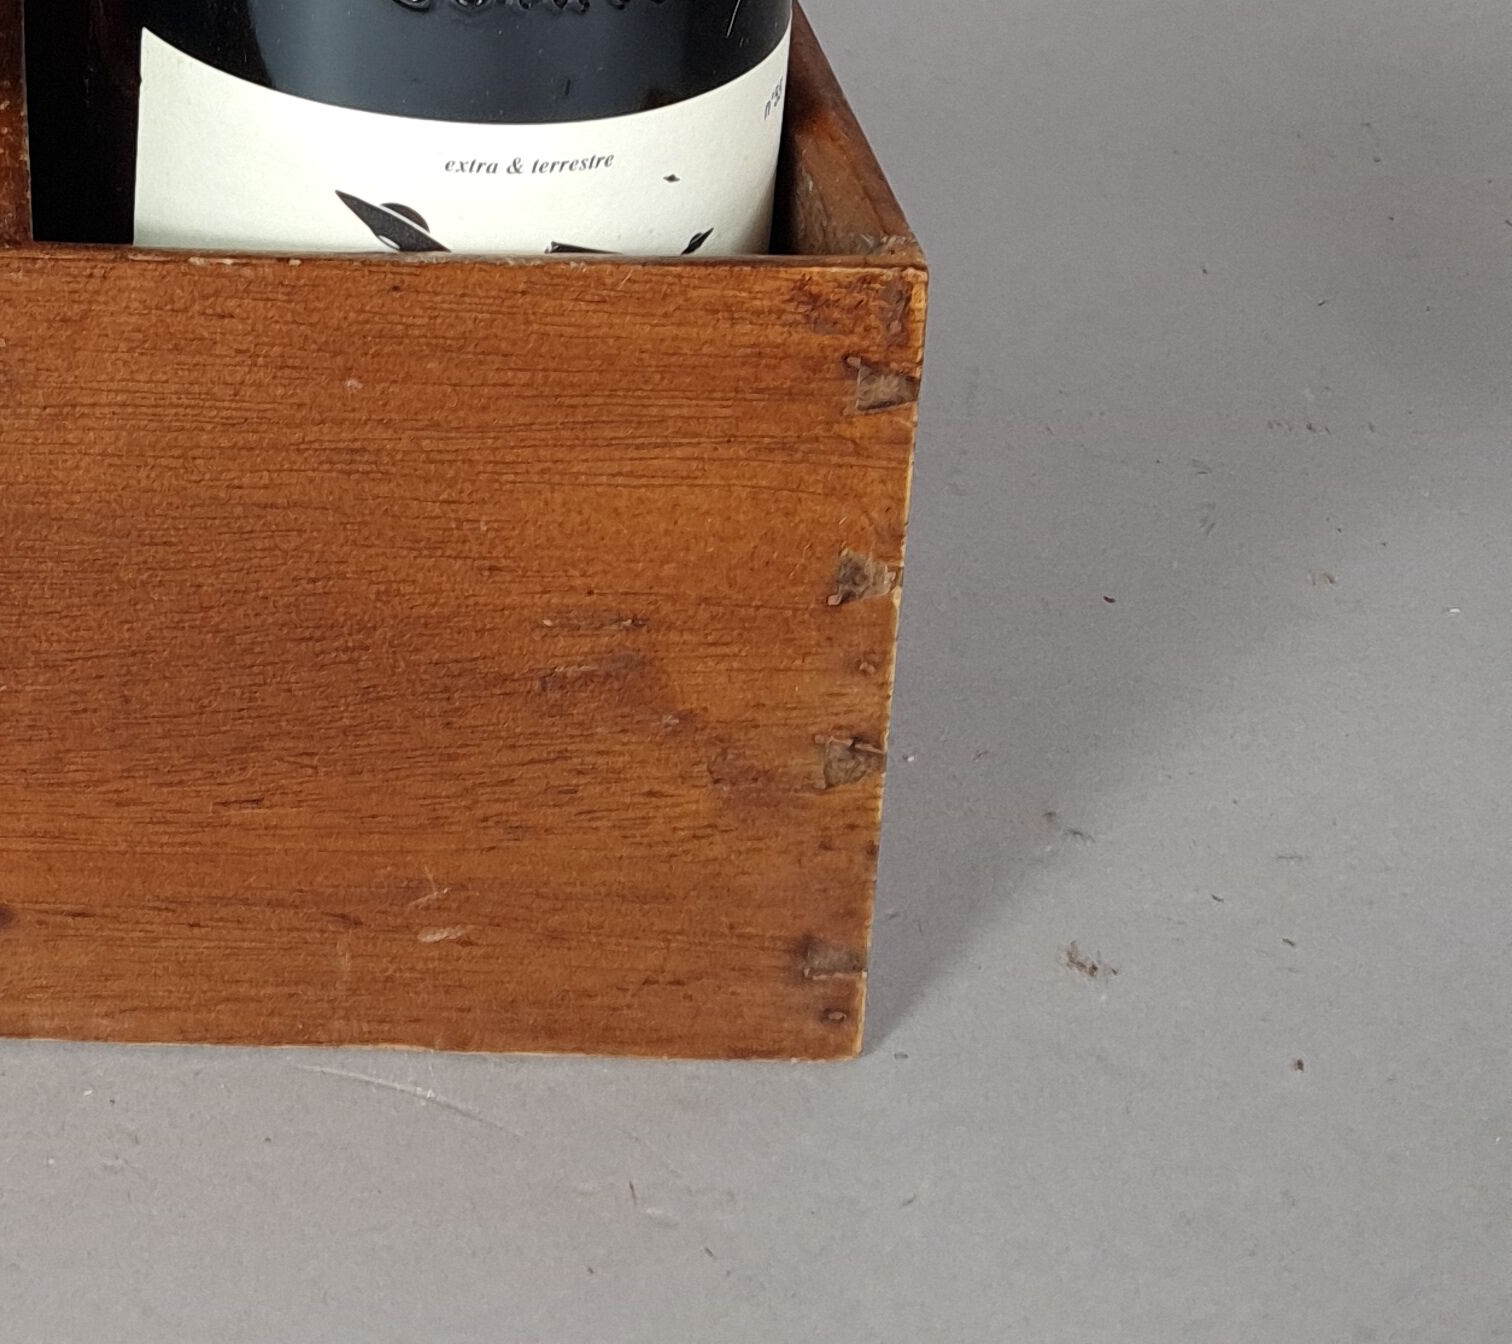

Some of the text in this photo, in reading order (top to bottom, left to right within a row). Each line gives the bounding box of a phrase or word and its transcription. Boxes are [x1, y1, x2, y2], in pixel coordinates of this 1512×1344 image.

[444, 153, 615, 175] extra & terrestre
